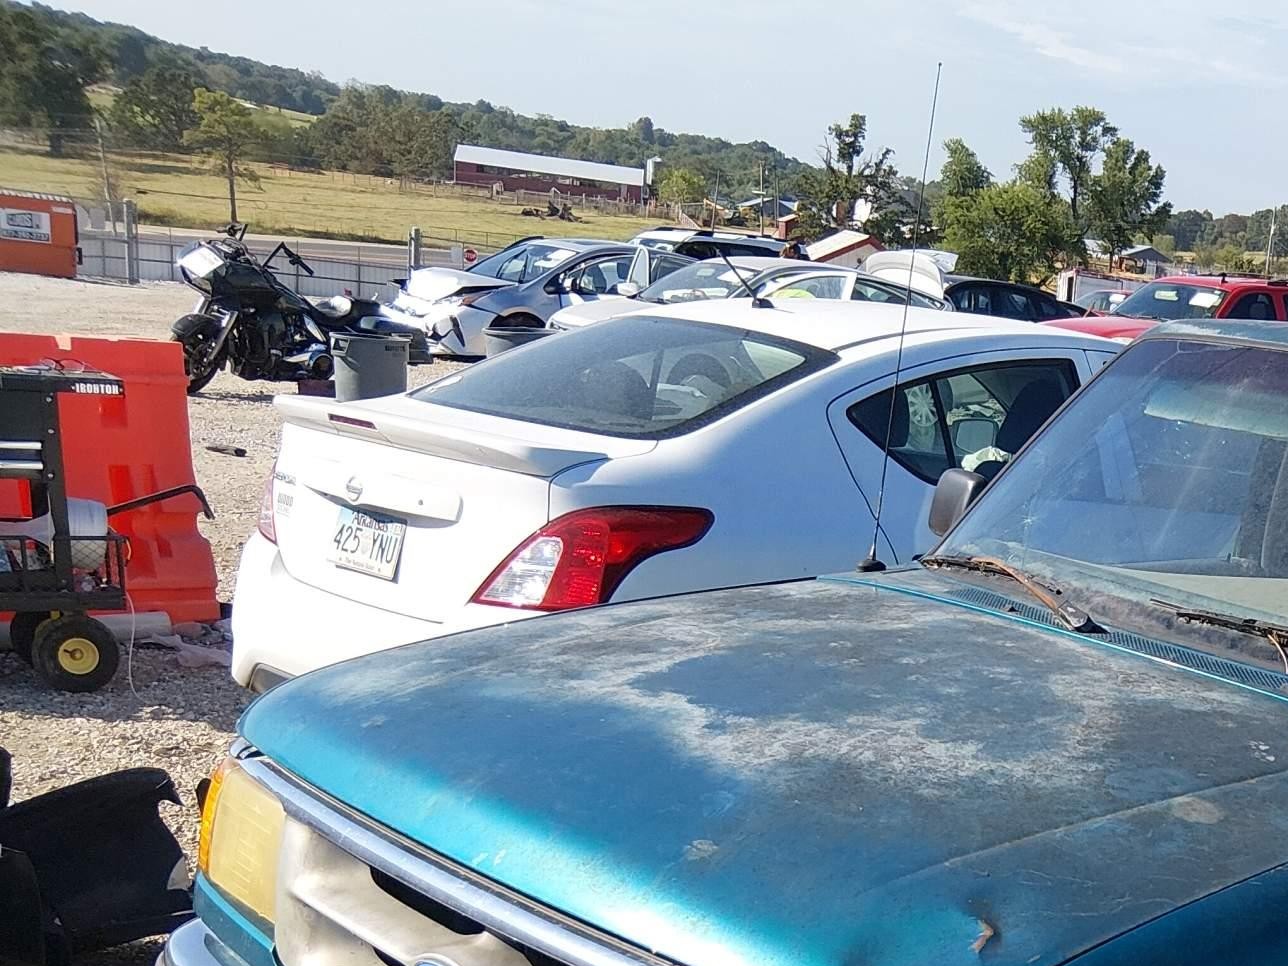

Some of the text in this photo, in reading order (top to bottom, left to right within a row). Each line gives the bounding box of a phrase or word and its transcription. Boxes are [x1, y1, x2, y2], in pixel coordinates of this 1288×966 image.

[75, 383, 119, 394] IRONTON
[334, 523, 363, 554] 425
[369, 531, 398, 564] YNU
